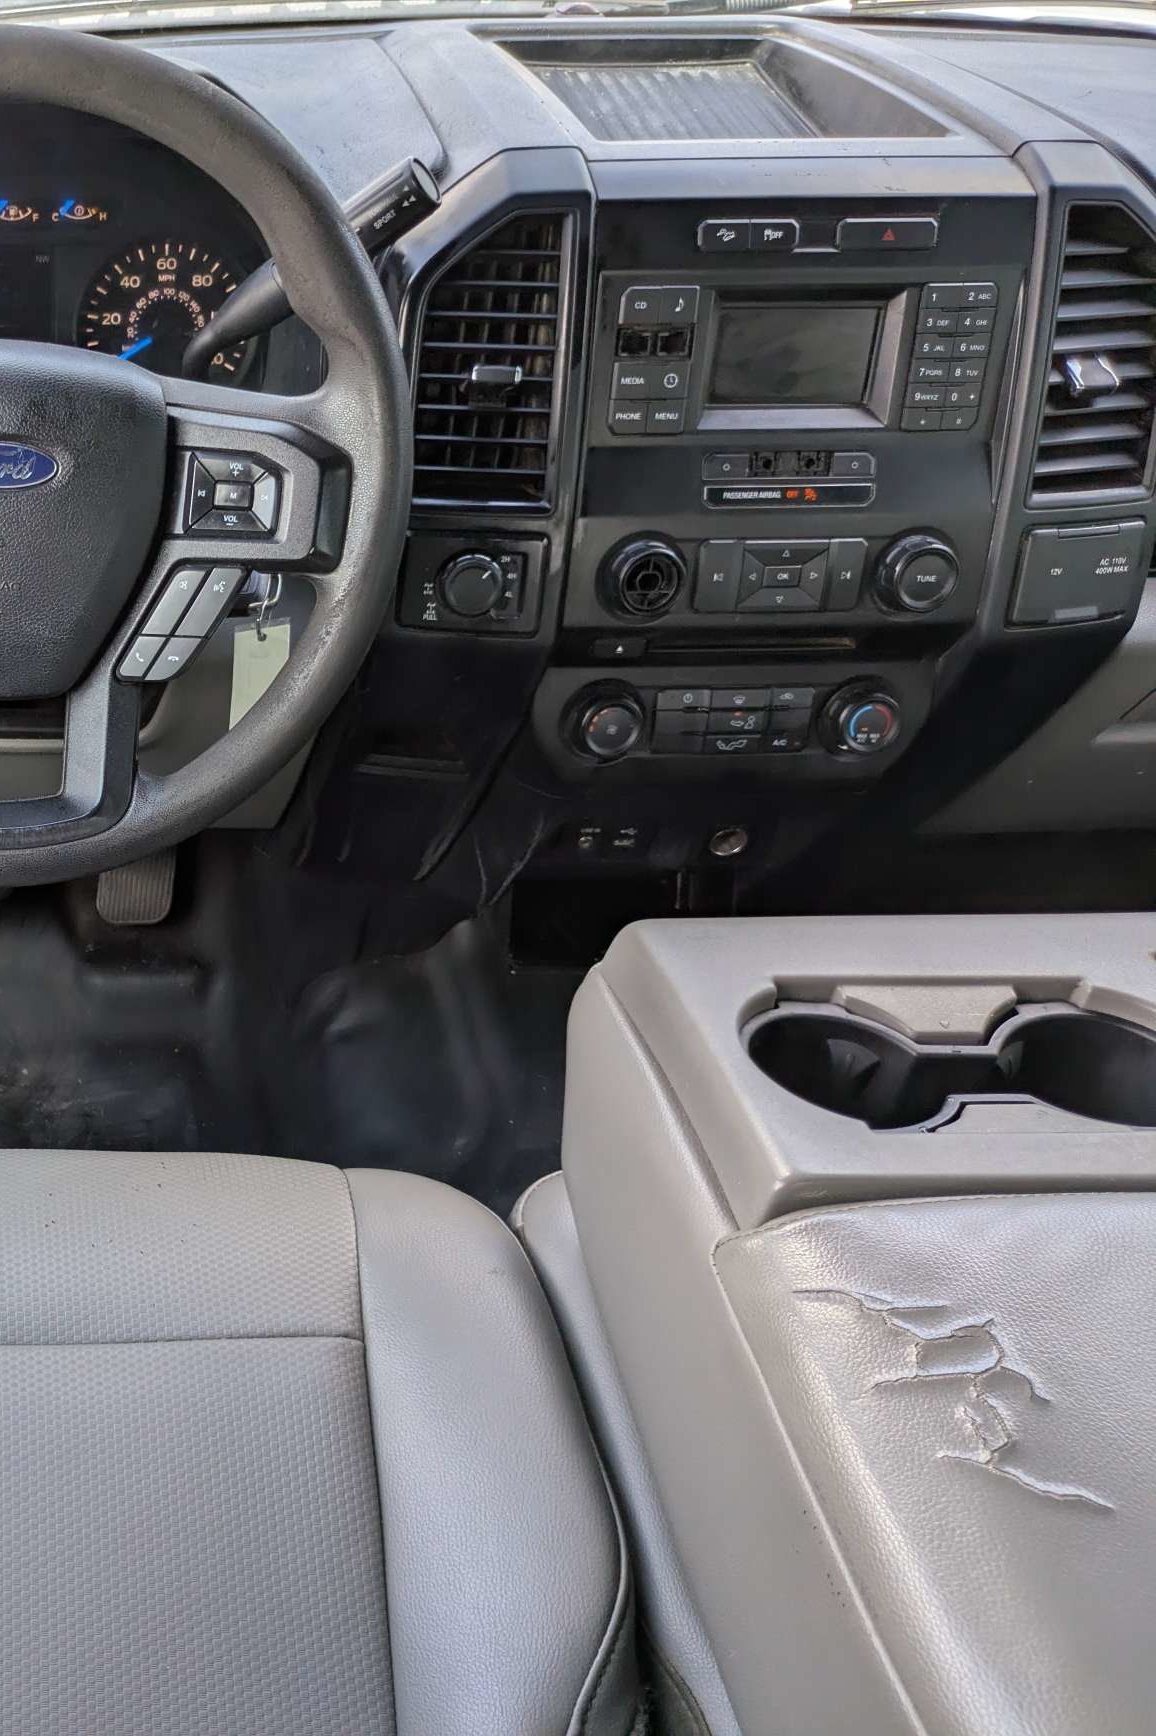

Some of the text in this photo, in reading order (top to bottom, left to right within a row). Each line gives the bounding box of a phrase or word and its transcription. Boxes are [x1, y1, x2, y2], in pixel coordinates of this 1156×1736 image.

[32, 214, 39, 222] F
[52, 214, 59, 222] C
[100, 212, 107, 221] H
[373, 209, 396, 229] SPORT
[156, 258, 176, 270] 60
[120, 276, 140, 288] 40
[158, 274, 175, 282] MPH
[192, 275, 212, 287] 80
[932, 293, 936, 301] 1
[968, 292, 974, 300] 2
[634, 302, 648, 310] CD
[102, 313, 121, 326] 20
[926, 318, 933, 326] 3
[964, 318, 970, 326] 4
[924, 343, 929, 352] 5
[960, 343, 966, 351] 6
[919, 368, 925, 376] 7
[955, 368, 961, 376] 8
[914, 392, 920, 400] 9
[951, 393, 957, 401] 0
[655, 412, 678, 420] MENU
[230, 462, 244, 470] VOL
[722, 491, 758, 499] PASSENGER
[758, 491, 781, 499] AIRBAG
[224, 514, 238, 522] VOL
[1100, 558, 1109, 566] AC
[1050, 568, 1063, 576] 12V
[1095, 565, 1129, 575] 400W MAX
